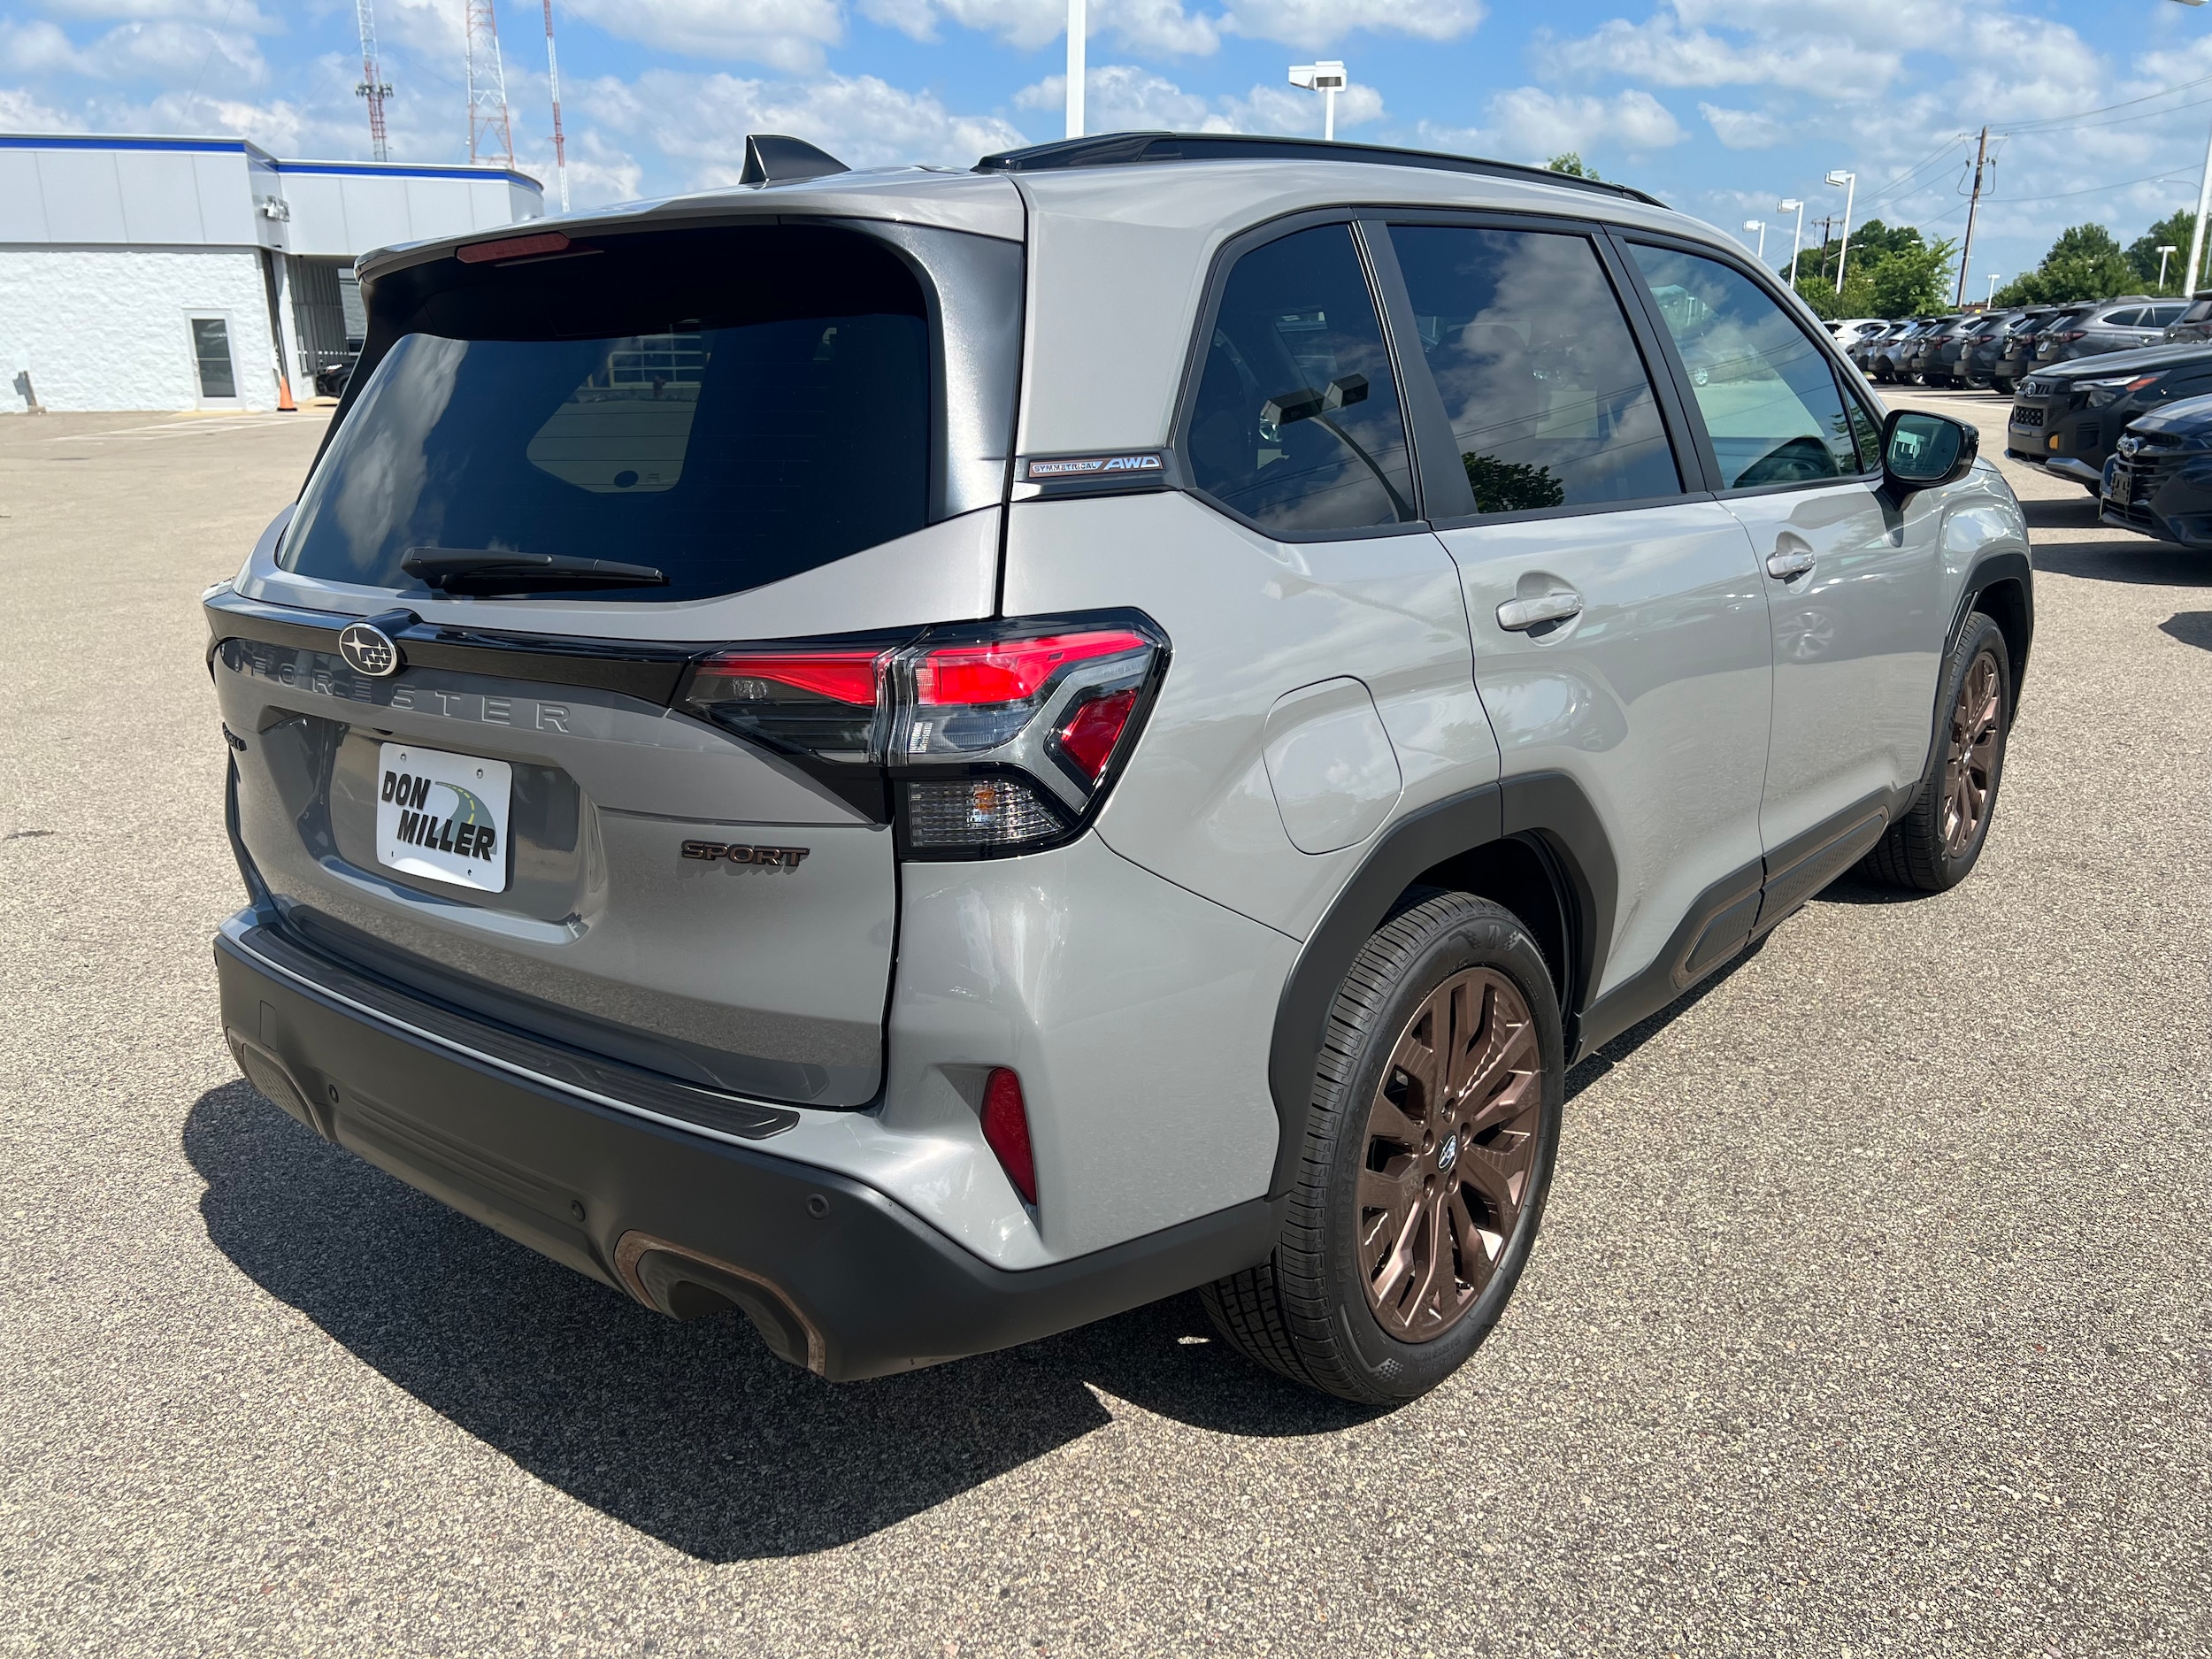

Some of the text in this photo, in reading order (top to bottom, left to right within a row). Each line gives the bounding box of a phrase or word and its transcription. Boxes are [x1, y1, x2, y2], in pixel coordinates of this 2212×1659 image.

[1033, 456, 1159, 473] SYMMETRICAL AWD
[250, 656, 572, 733] FORESTER
[380, 770, 432, 811] DON
[396, 810, 496, 862] MILLER
[681, 840, 810, 867] SPORT
